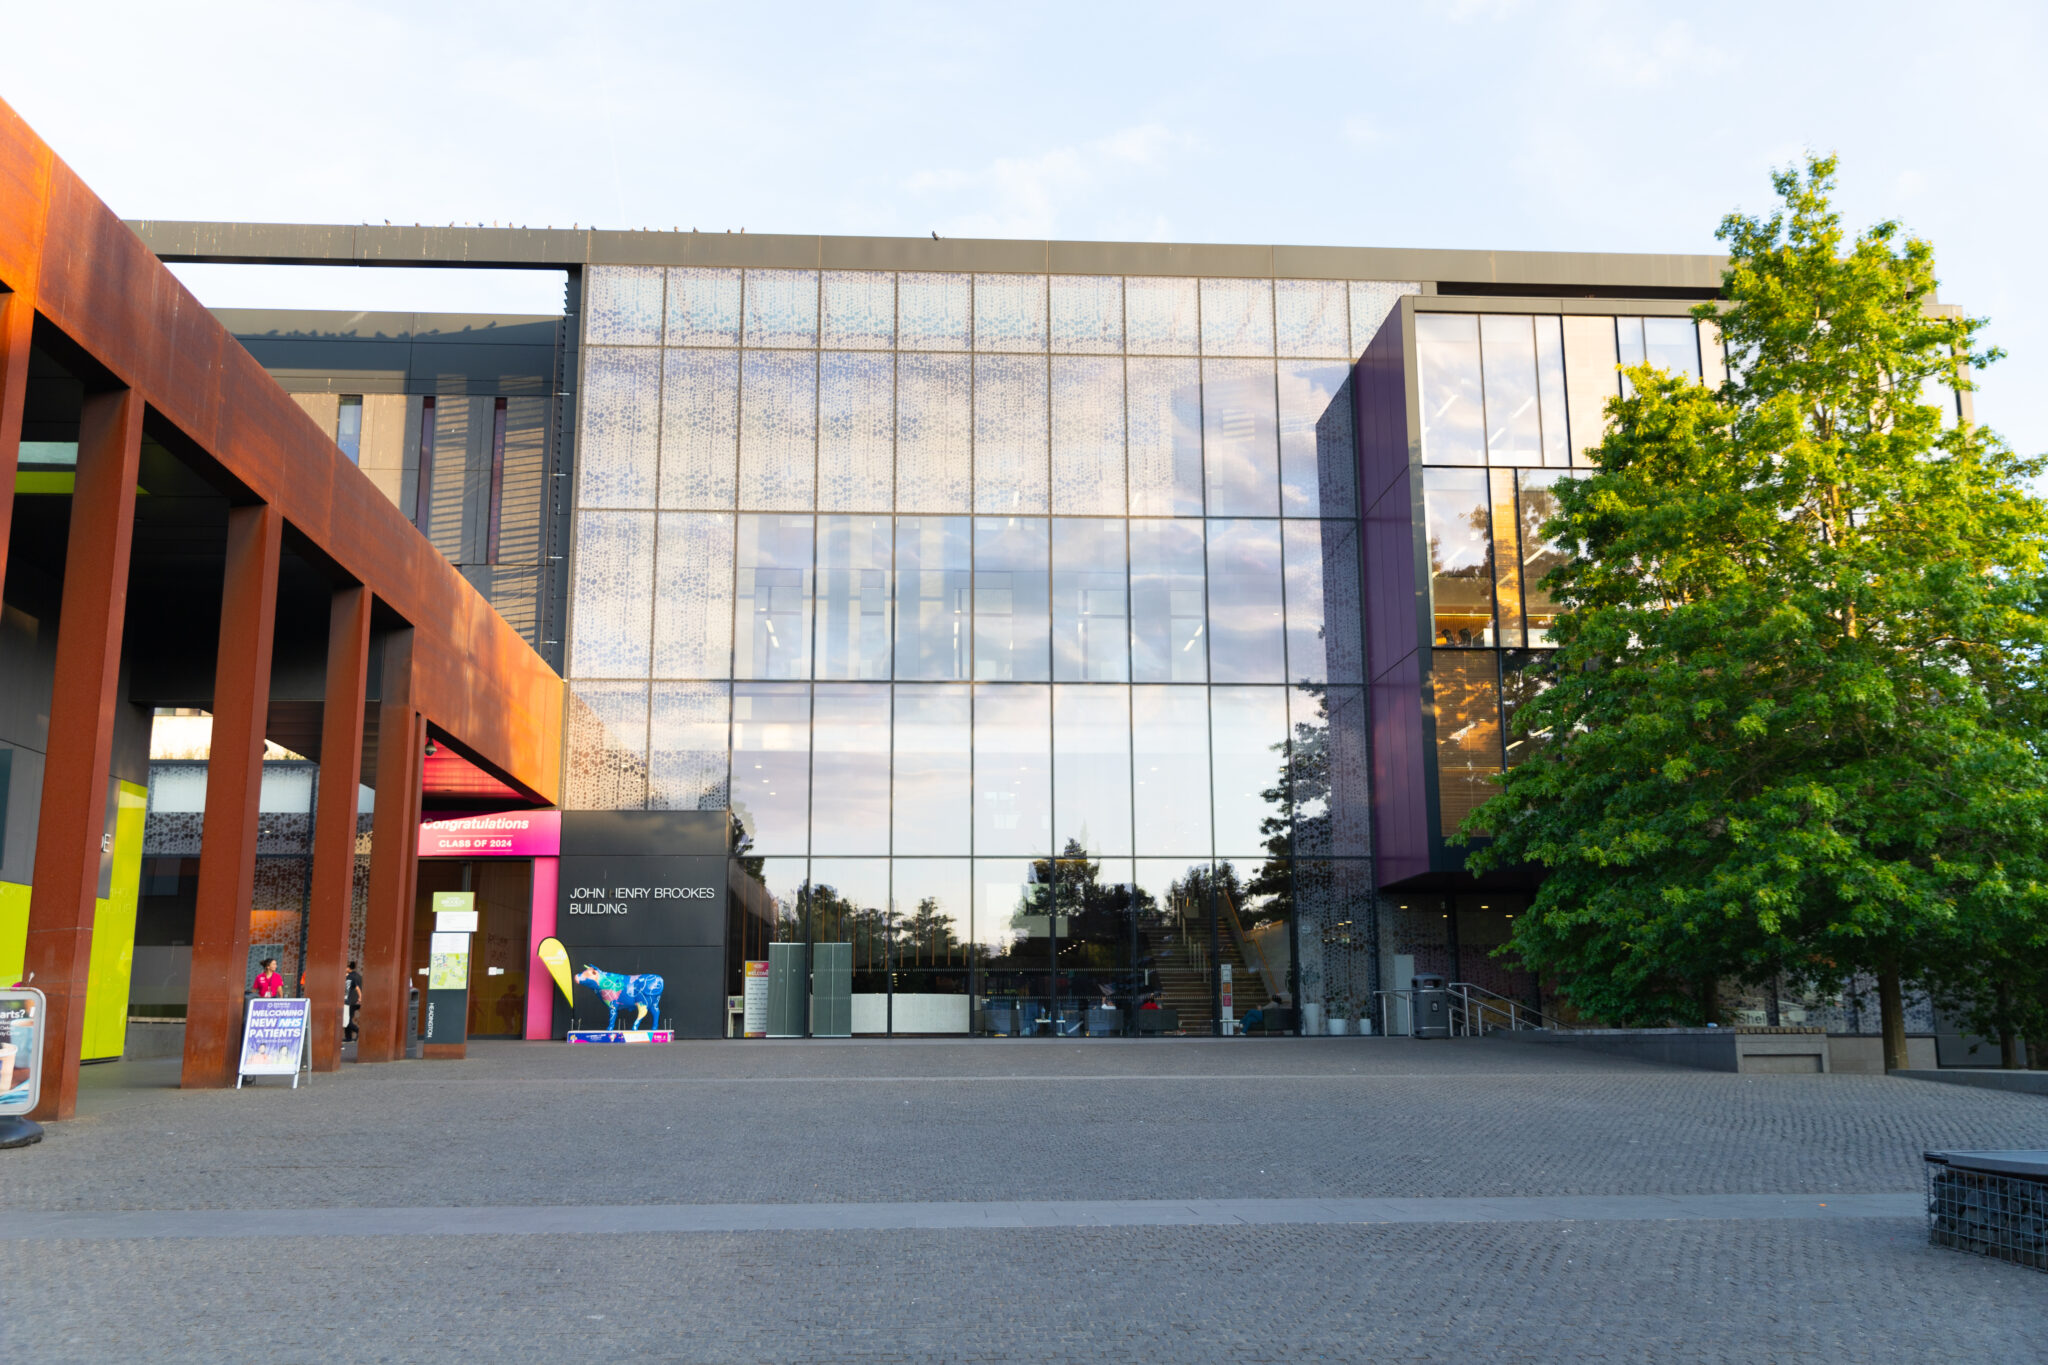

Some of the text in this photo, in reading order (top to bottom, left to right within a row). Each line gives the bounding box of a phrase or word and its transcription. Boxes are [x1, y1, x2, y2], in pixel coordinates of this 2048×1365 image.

[422, 818, 529, 831] Congratulations
[438, 839, 512, 848] CLASS OF 2024
[570, 887, 605, 899] JOHN
[654, 887, 715, 899] BROOKES
[569, 903, 628, 915] BUILDING
[252, 1009, 304, 1017] WELCOMING
[250, 1018, 302, 1028] NEW NHS
[249, 1028, 301, 1038] PATIENTS
